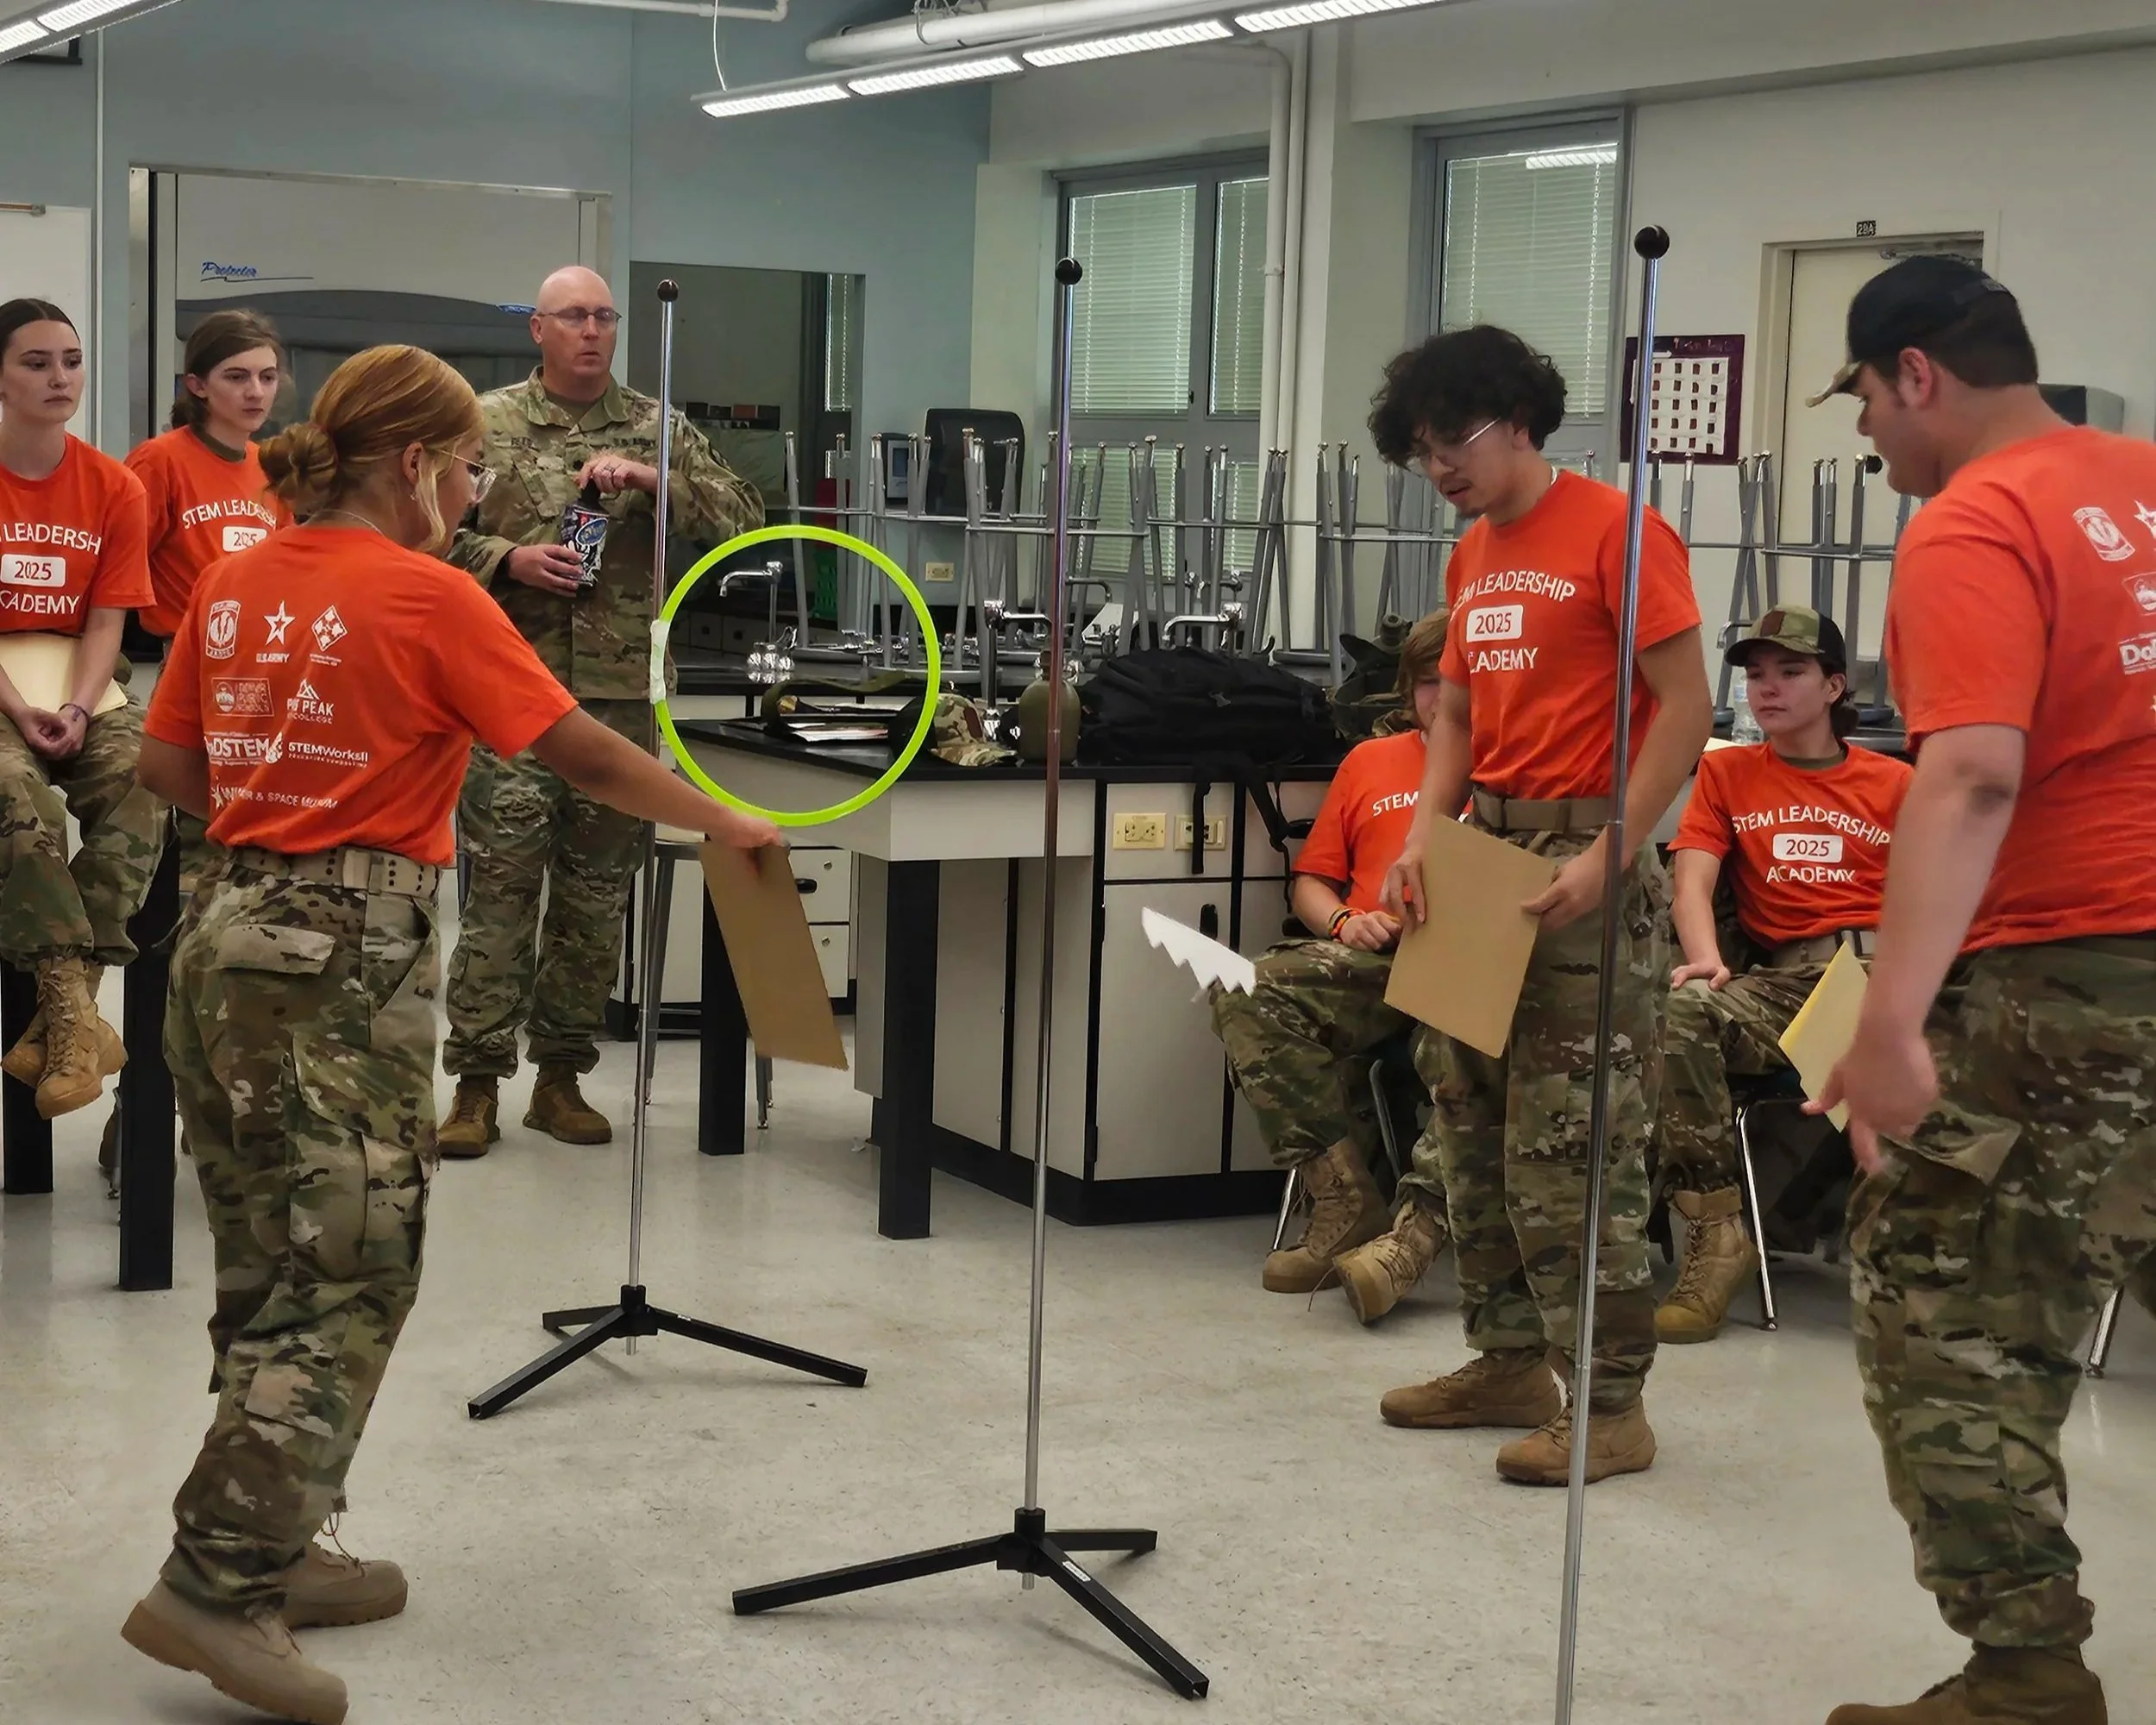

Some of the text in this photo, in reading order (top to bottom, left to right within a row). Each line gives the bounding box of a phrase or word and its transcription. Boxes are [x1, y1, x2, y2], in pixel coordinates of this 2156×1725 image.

[182, 501, 222, 530] STEM
[15, 561, 52, 580] 2025
[1476, 570, 1576, 602] LEADERSHIP
[1475, 612, 1512, 635] 2025
[303, 699, 334, 717] PEAK
[256, 792, 264, 801] &
[267, 792, 298, 806] SPACE
[1372, 791, 1419, 817] STEM
[1732, 806, 1890, 847] STEM LEADERSHIP
[1785, 839, 1830, 856] 2025
[1766, 866, 1855, 883] ACADEMY
